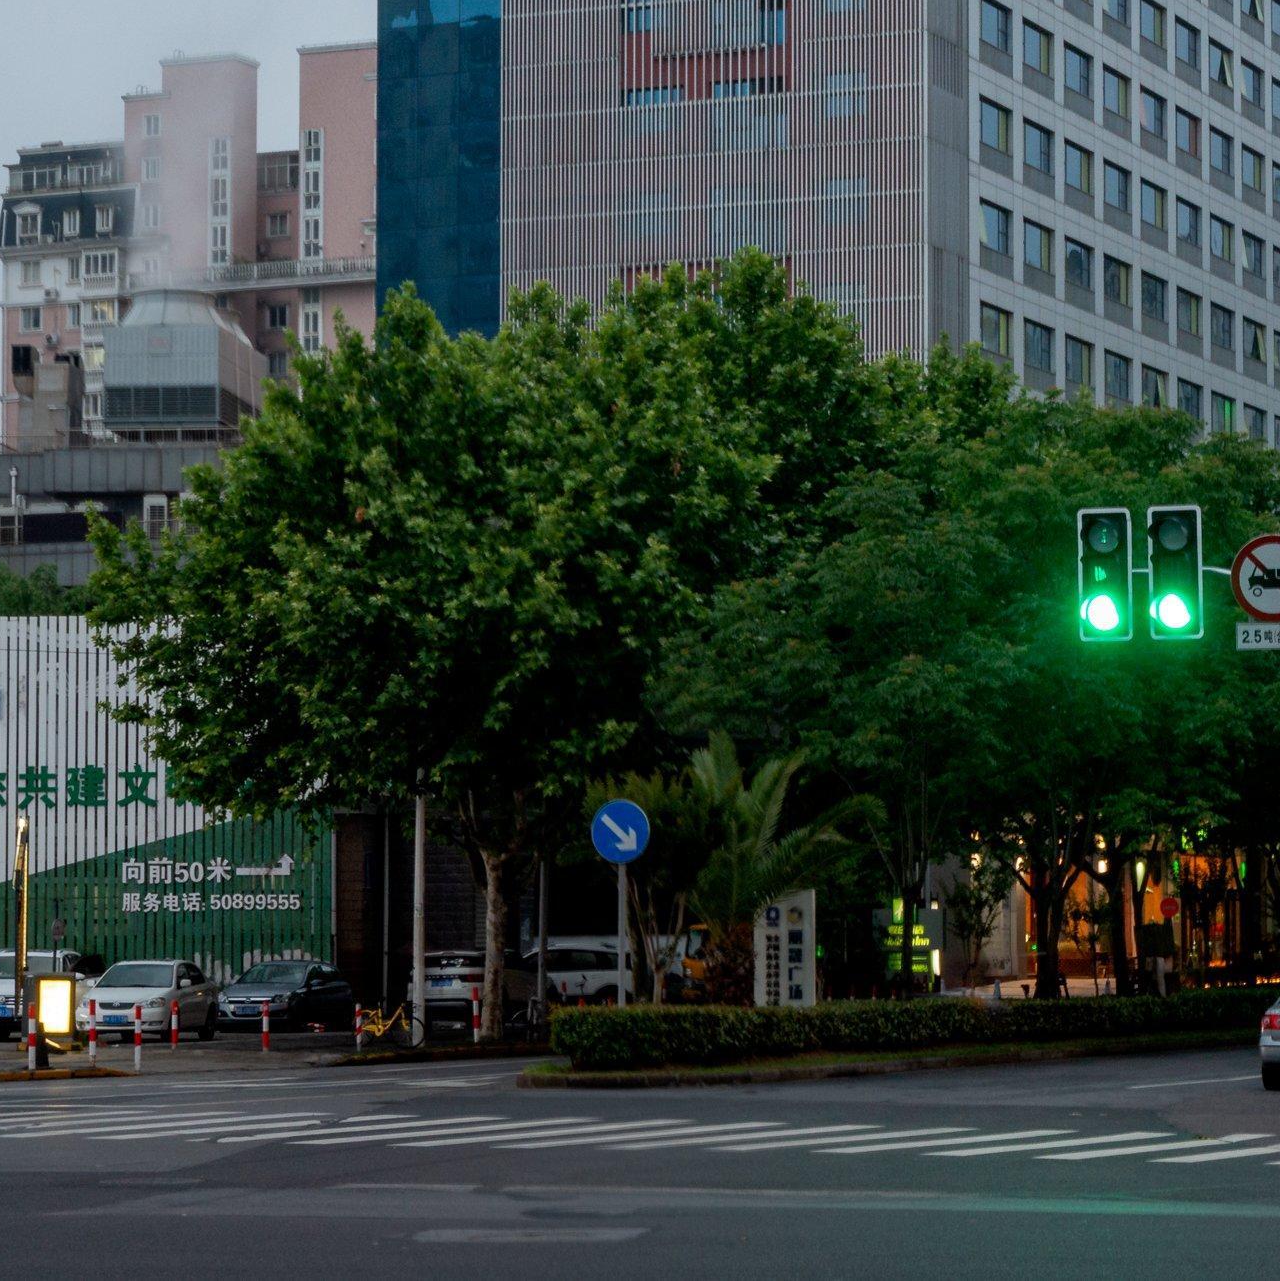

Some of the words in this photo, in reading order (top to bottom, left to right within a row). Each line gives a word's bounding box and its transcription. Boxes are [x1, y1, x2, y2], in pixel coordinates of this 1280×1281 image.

[122, 856, 232, 885] 向前50米
[122, 892, 206, 912] 服务电话:
[210, 893, 301, 910] 50899555
